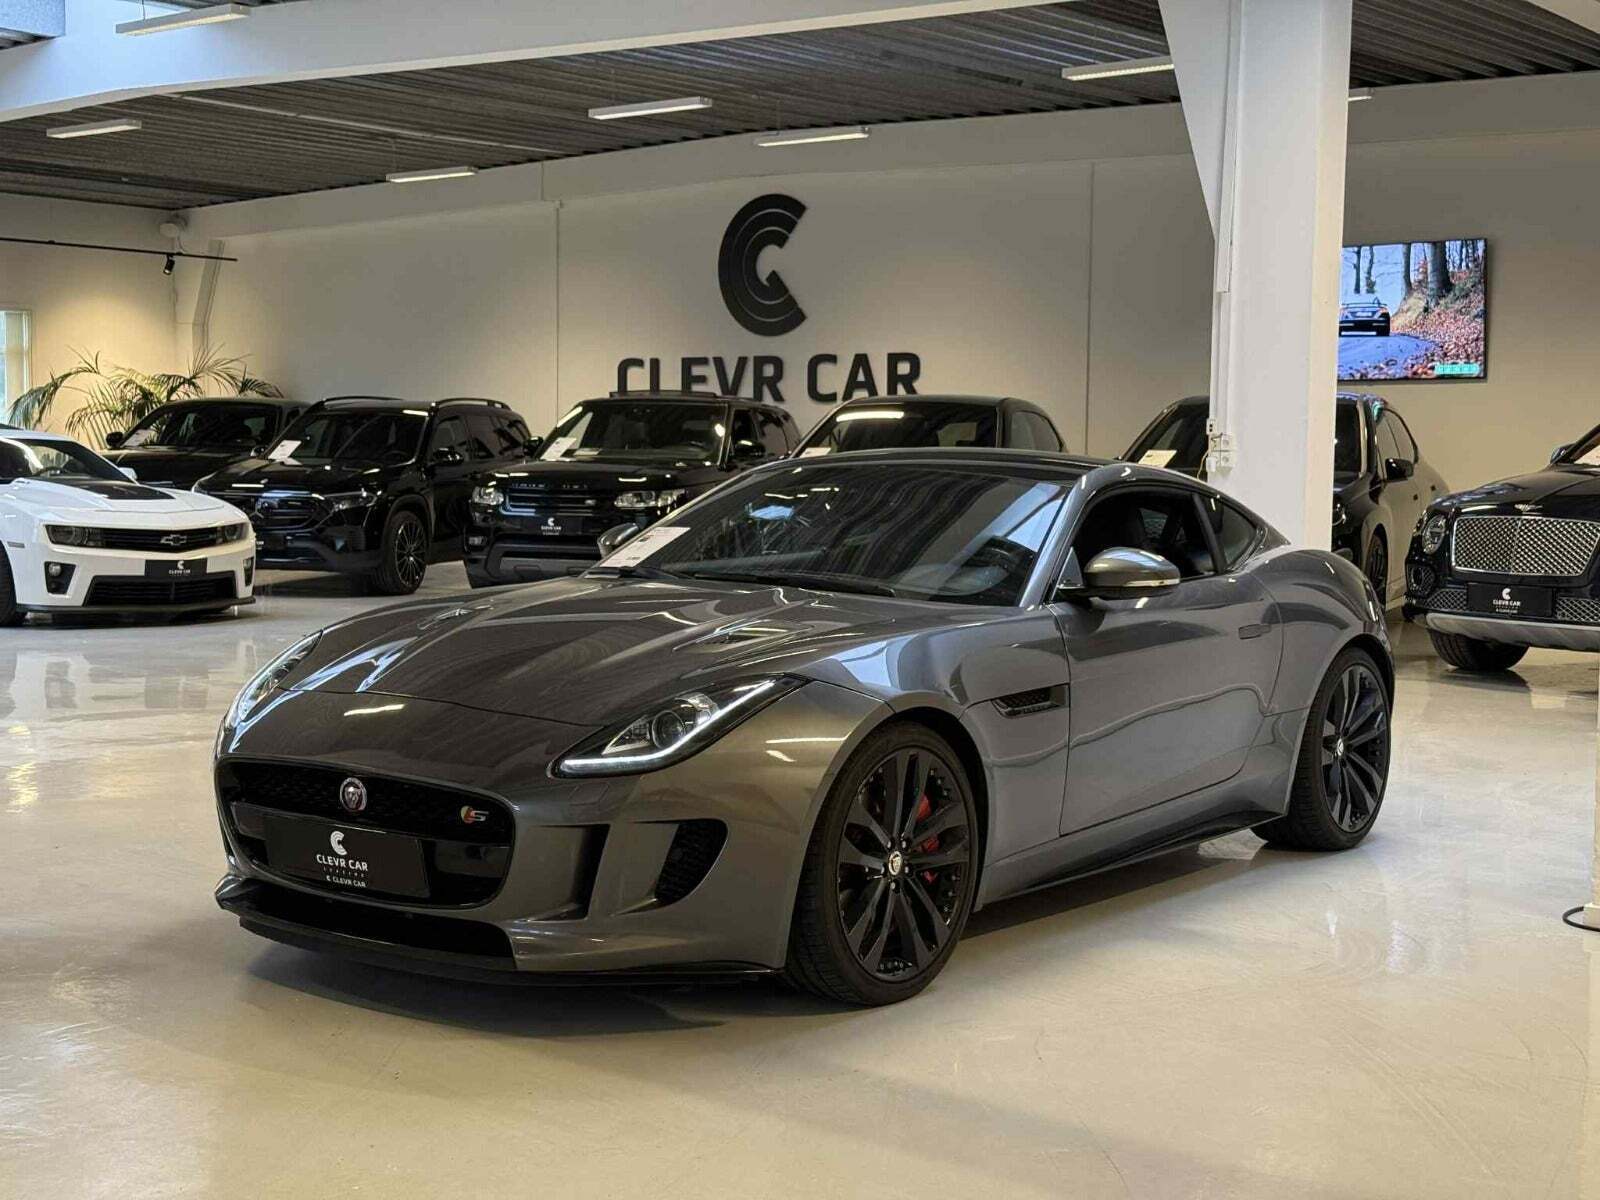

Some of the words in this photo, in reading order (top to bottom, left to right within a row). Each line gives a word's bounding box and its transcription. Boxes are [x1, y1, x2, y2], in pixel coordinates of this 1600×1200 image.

[617, 355, 785, 402] CLEVR
[807, 352, 921, 403] CAR
[316, 854, 346, 868] CLEVR
[348, 859, 369, 872] CAR
[352, 880, 367, 888] CAR
